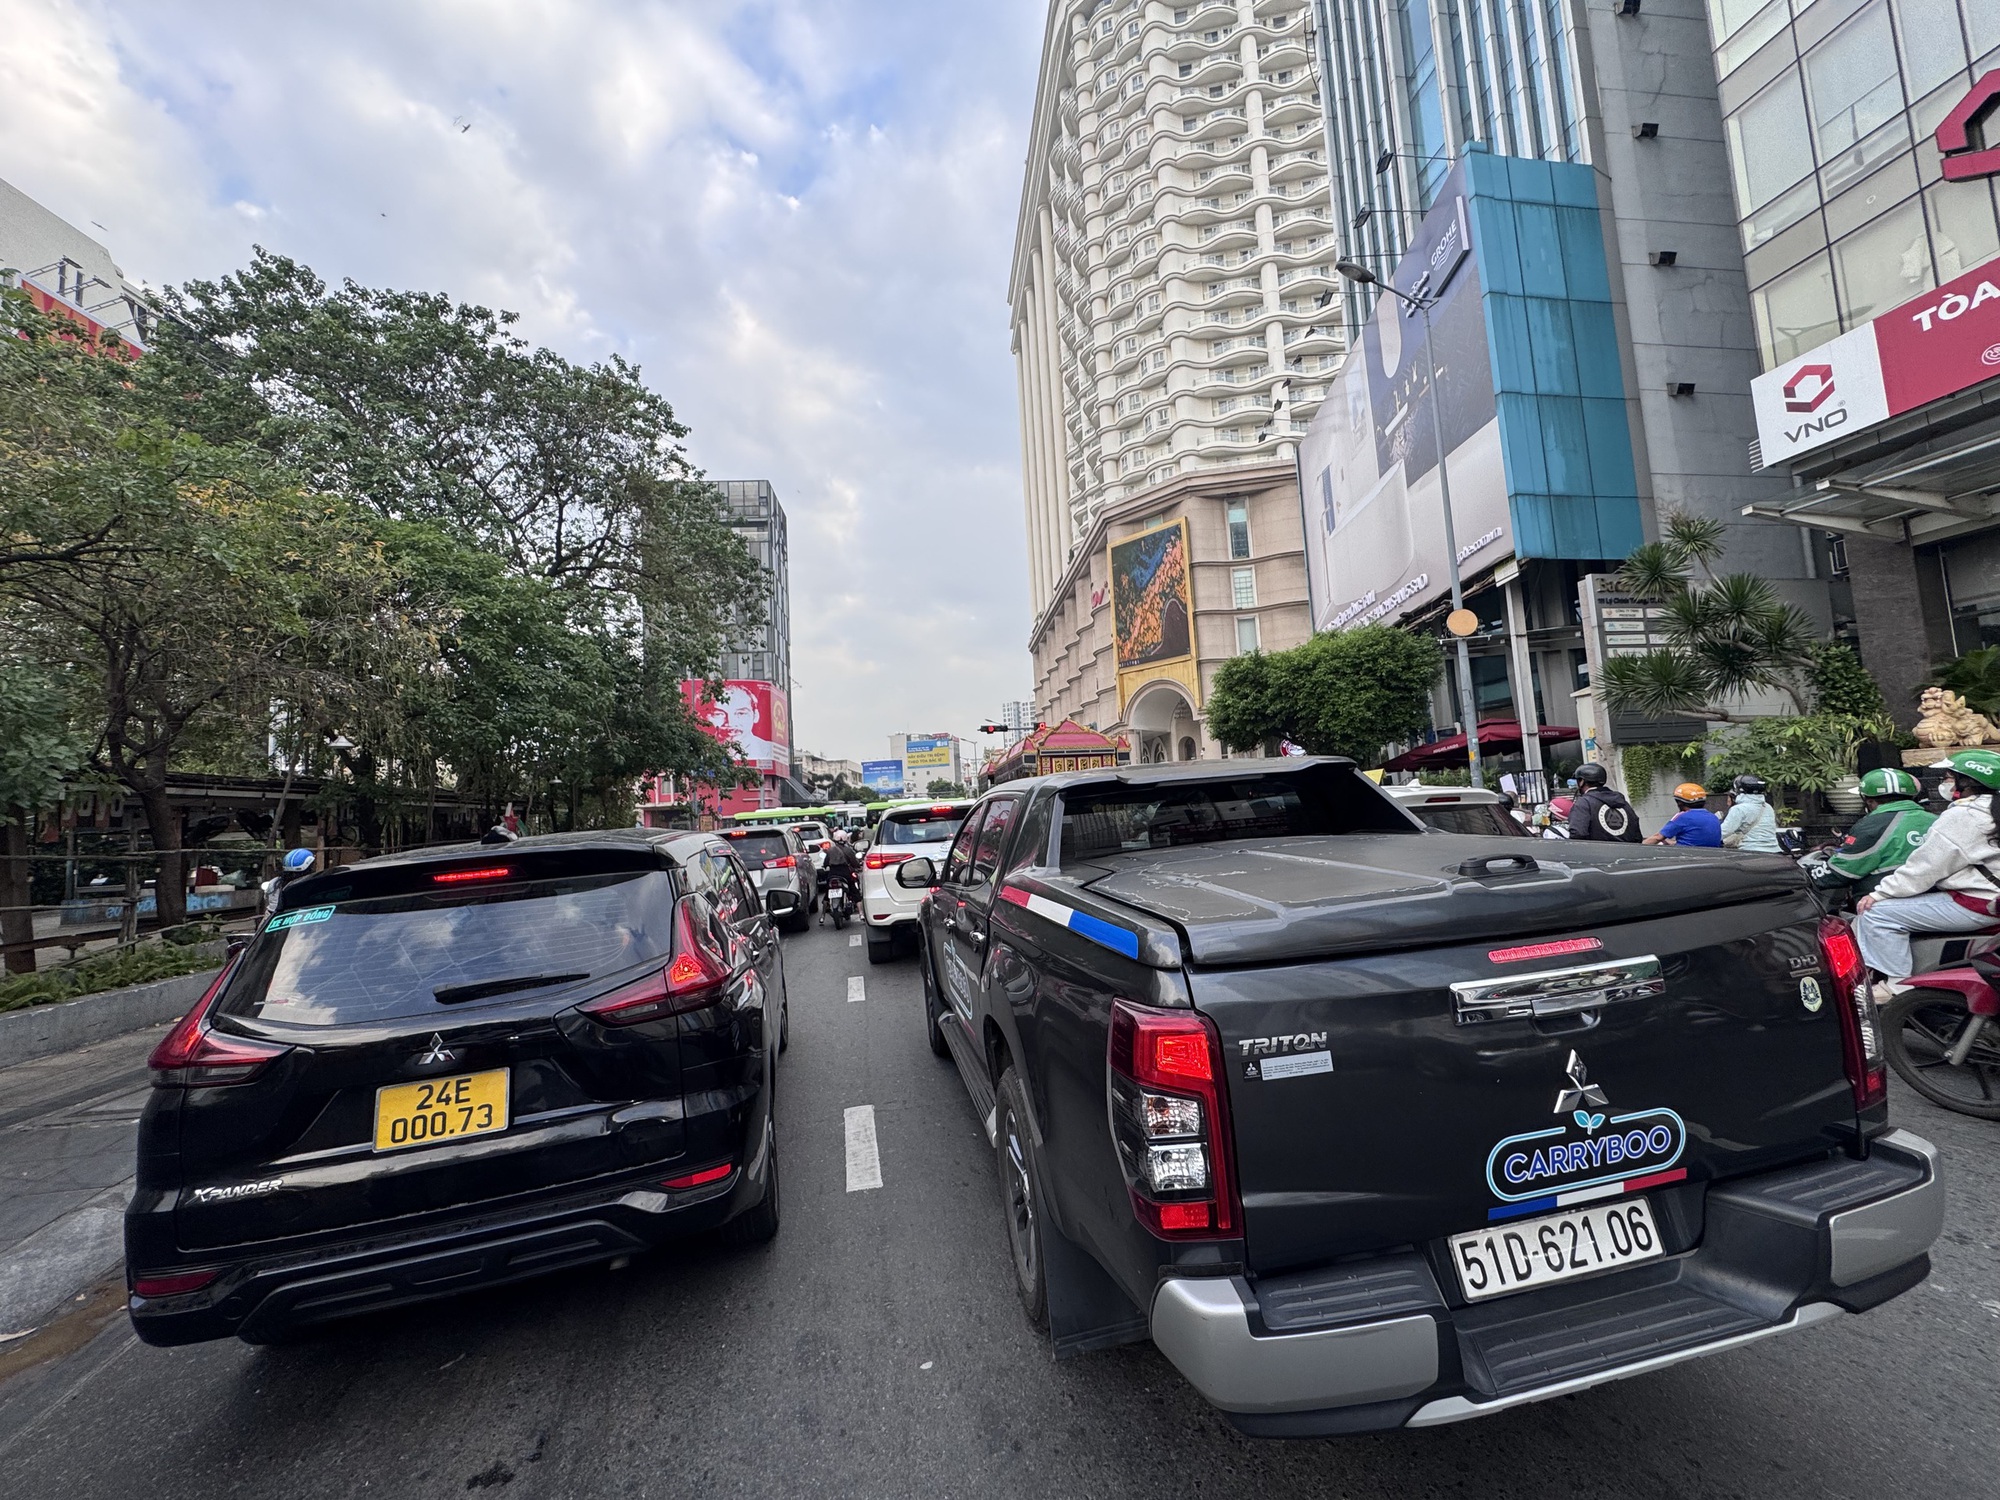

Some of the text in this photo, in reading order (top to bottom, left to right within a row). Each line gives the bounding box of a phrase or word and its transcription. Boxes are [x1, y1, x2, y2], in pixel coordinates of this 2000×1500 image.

[1431, 220, 1457, 266] GROHE
[1912, 281, 2000, 332] TÒA
[1784, 408, 1848, 443] VNO
[1964, 760, 1994, 776] Grab
[1906, 830, 1928, 847] Gr
[269, 918, 283, 928] XE
[1238, 1031, 1327, 1056] TRITON
[416, 1078, 472, 1111] 24E
[391, 1103, 493, 1144] 000.73
[1504, 1125, 1672, 1184] CARRYBOO
[190, 1179, 283, 1204] XPANDER
[1459, 1205, 1652, 1290] 51D-621.06
